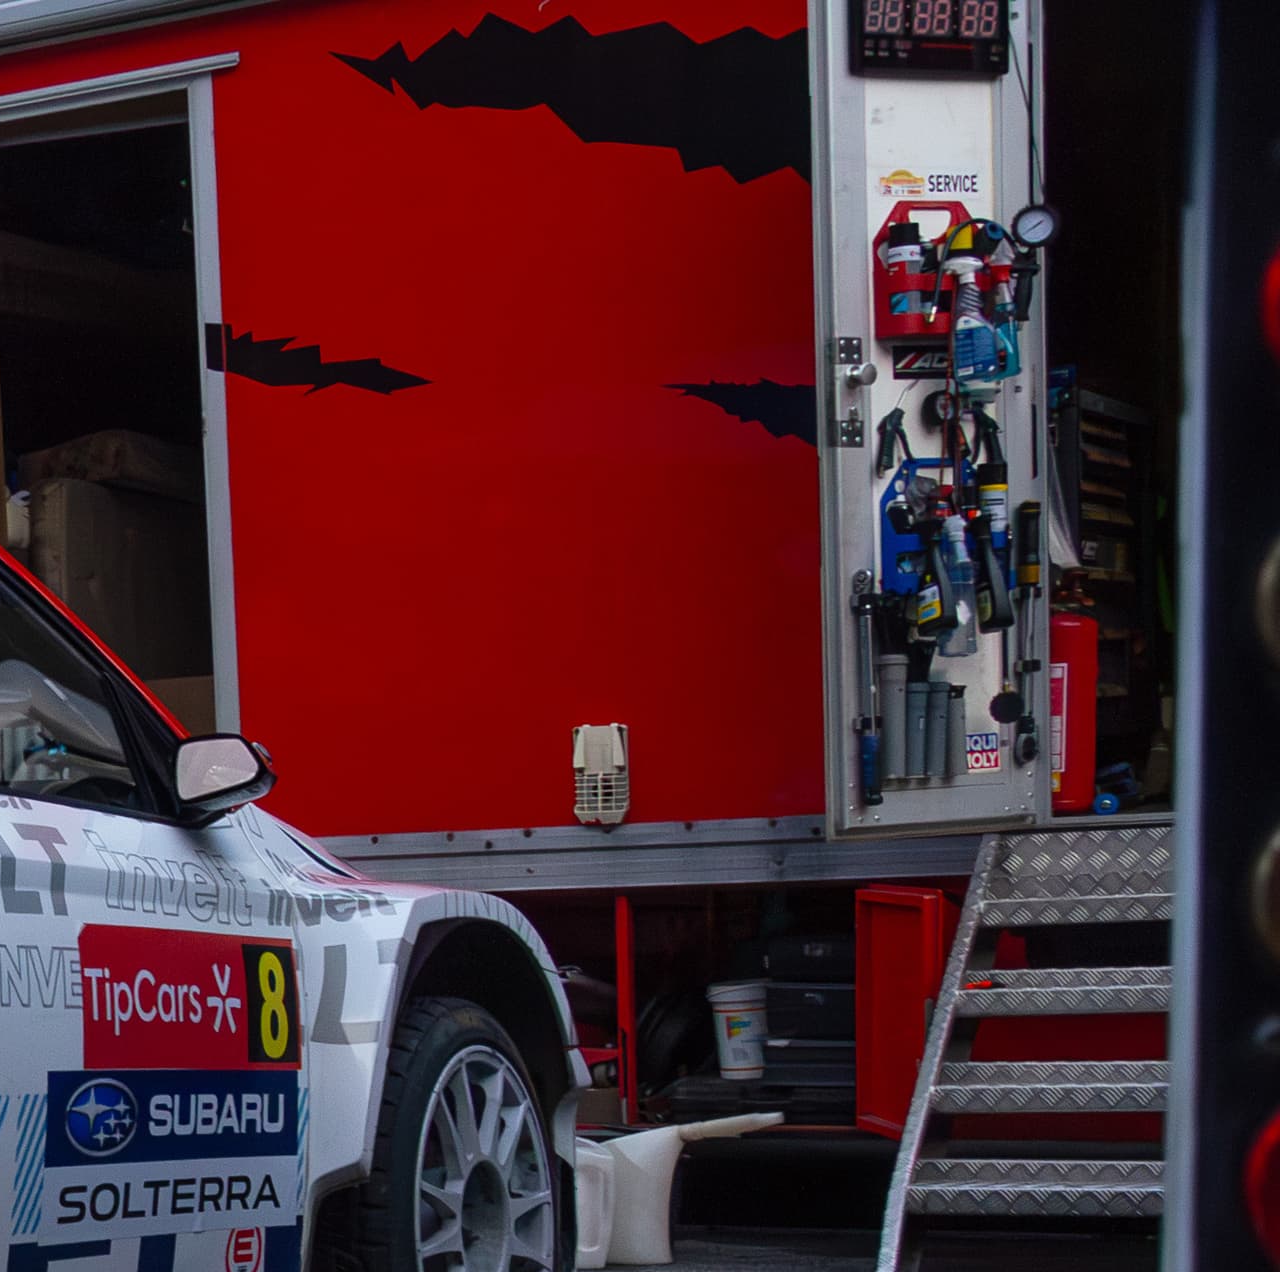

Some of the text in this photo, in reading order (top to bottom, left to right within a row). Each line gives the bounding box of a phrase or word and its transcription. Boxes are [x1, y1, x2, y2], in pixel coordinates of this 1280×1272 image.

[927, 174, 979, 193] SERVICE
[82, 829, 254, 927] invelt
[83, 967, 203, 1036] TipCars
[257, 950, 289, 1059] 8
[148, 1093, 287, 1137] SUBARU
[56, 1173, 282, 1225] SOLTERRA
